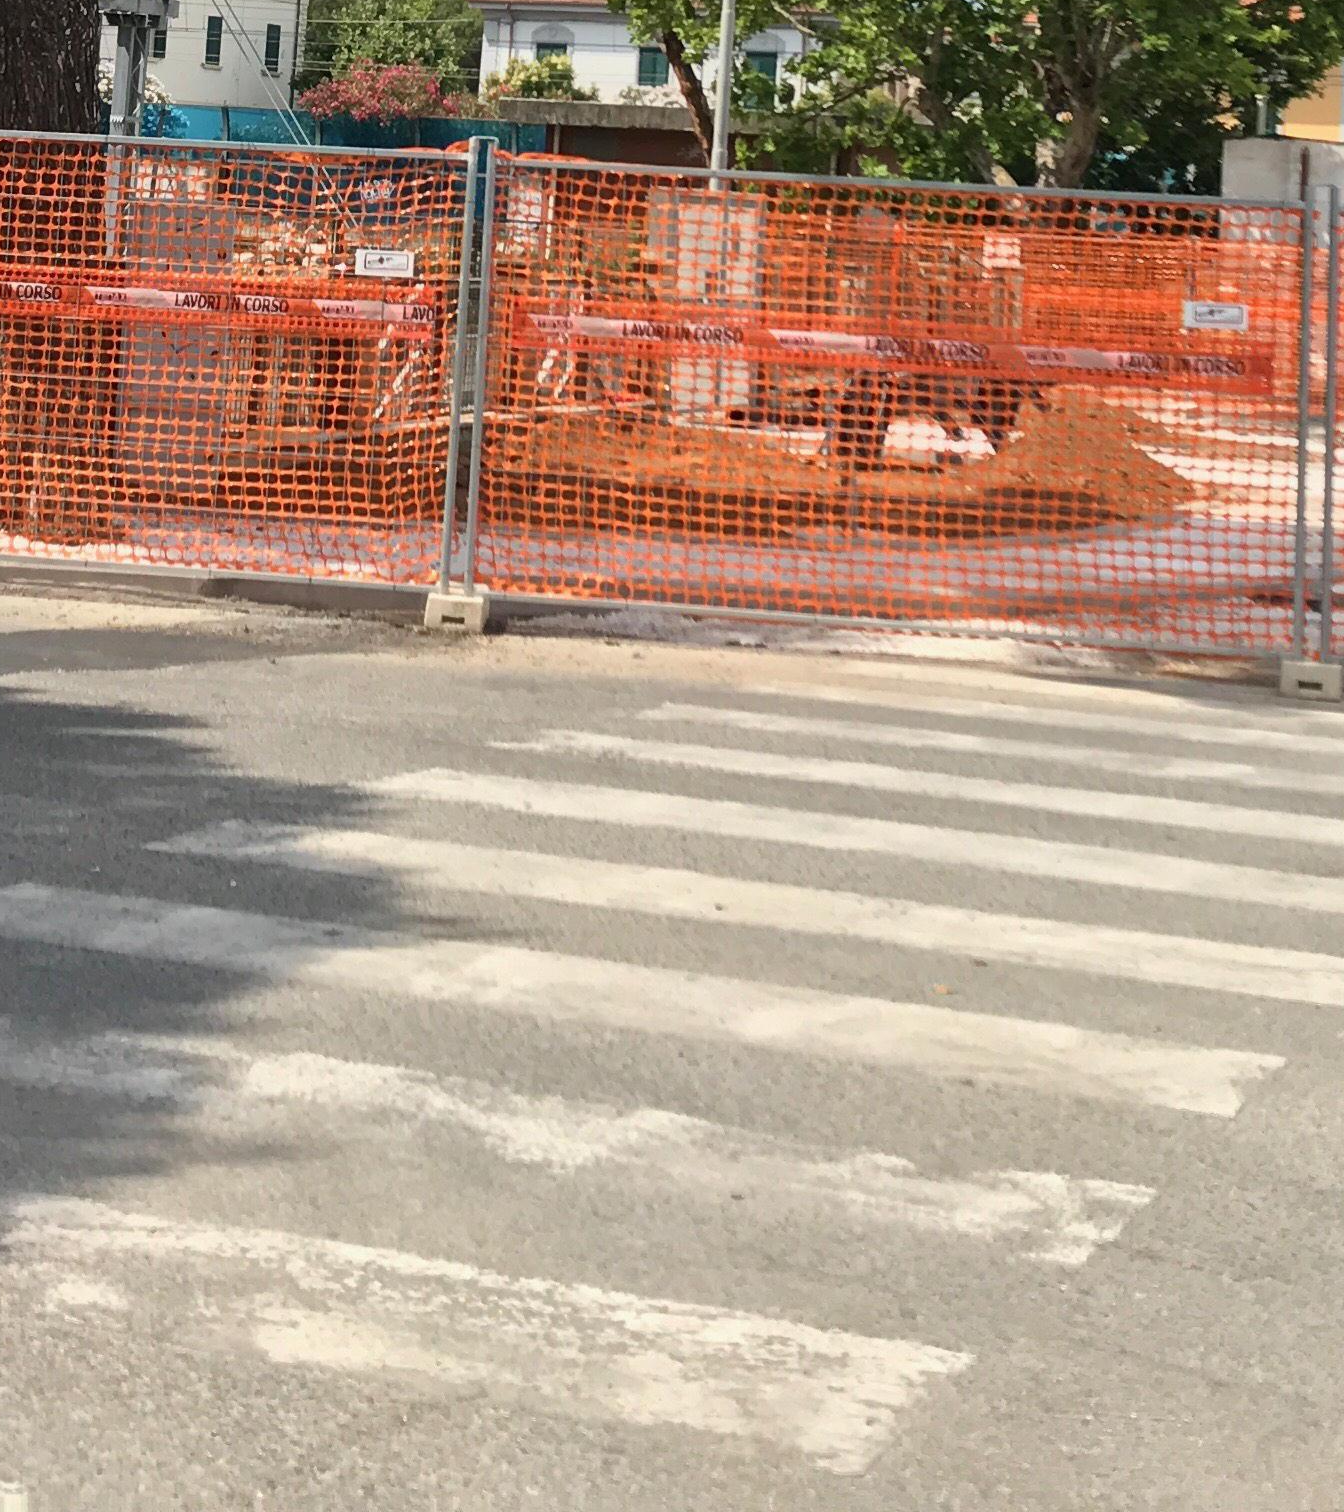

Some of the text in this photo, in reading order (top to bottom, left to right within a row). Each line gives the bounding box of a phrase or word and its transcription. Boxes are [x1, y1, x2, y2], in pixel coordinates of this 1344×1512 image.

[15, 283, 63, 300] CORSO
[174, 292, 290, 313] LAVORI IN CORSO
[622, 322, 743, 344] LAVORI IN CORSO
[864, 336, 914, 356] LAVORI
[940, 340, 990, 361] CORSO
[1118, 353, 1169, 372] LAVORI
[1192, 357, 1246, 376] CORSO
